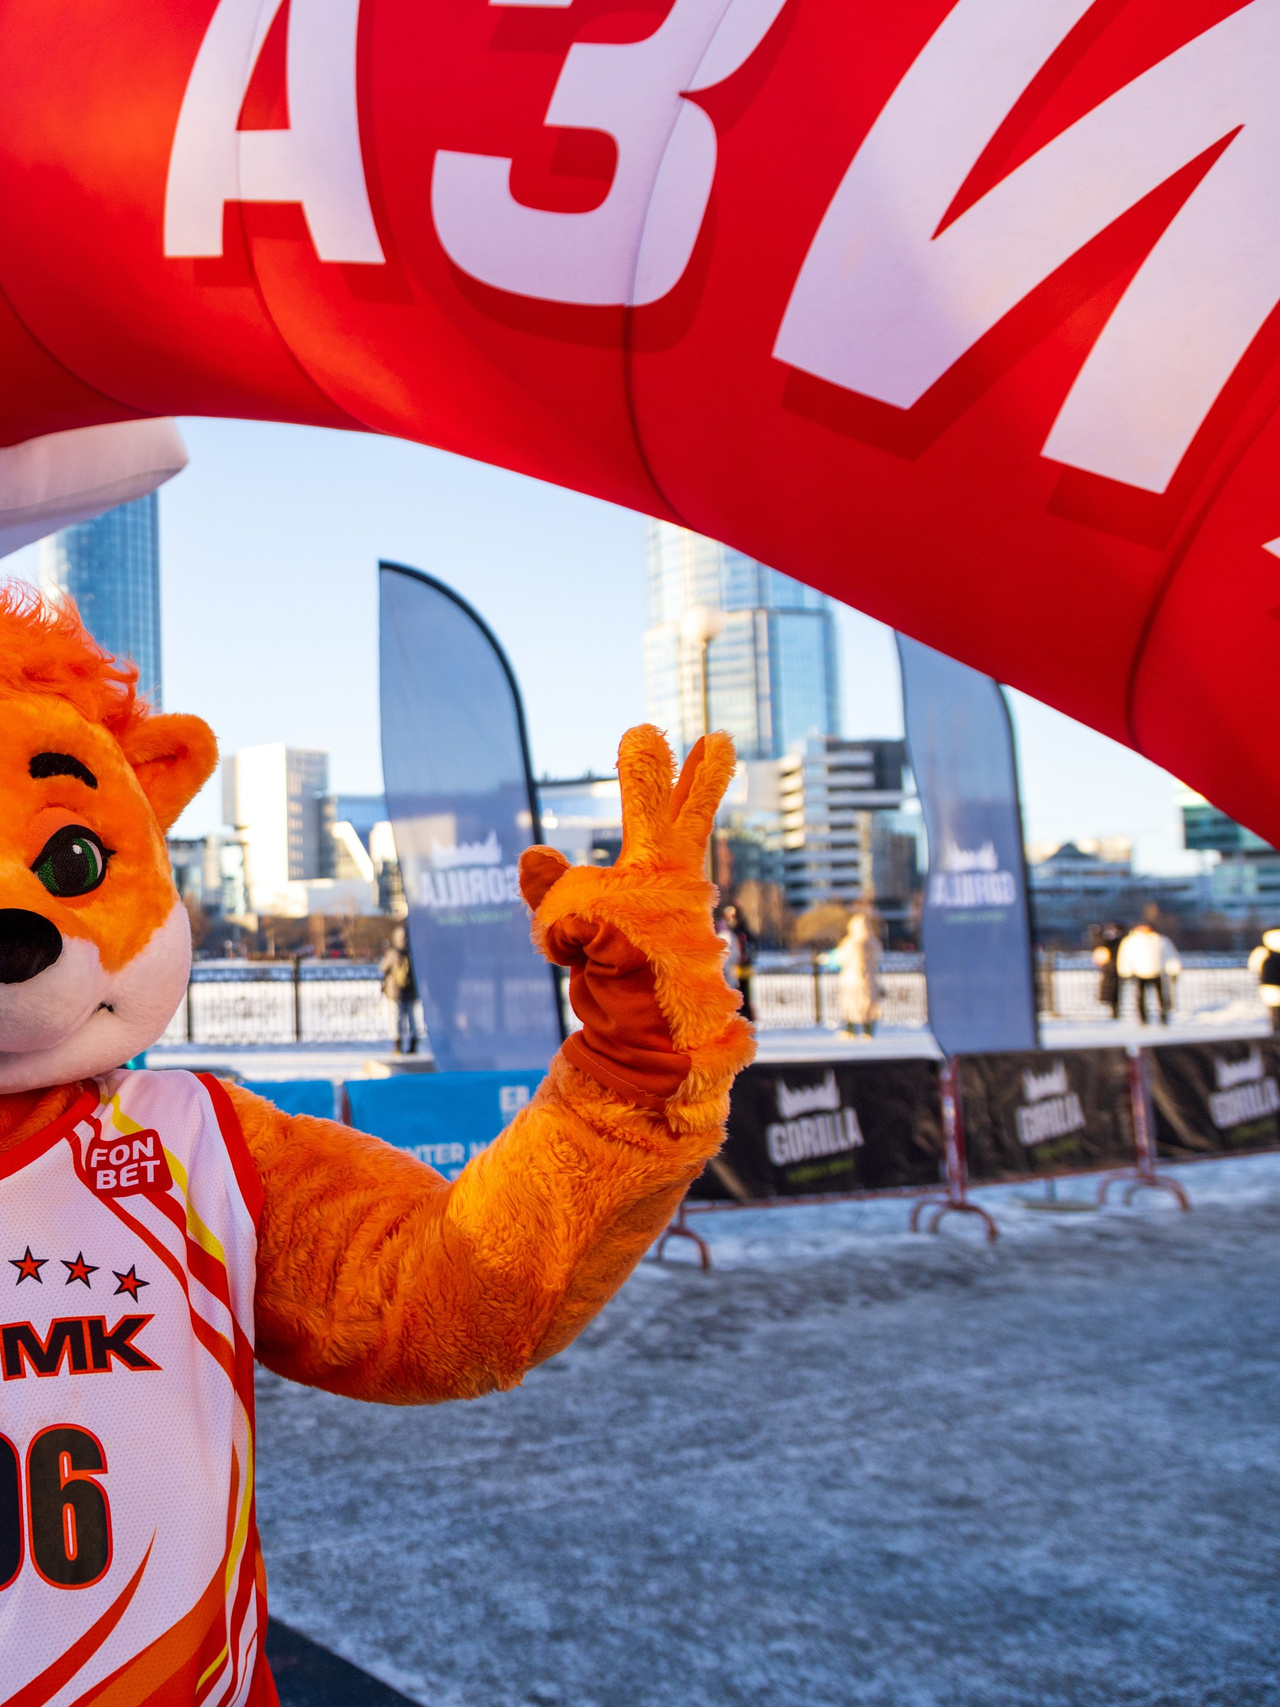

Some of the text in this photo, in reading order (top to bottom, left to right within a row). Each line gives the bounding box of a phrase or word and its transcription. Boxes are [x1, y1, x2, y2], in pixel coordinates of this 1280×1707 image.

[90, 1136, 154, 1168] FON
[766, 1106, 865, 1167] GORILLA
[96, 1160, 161, 1190] BET
